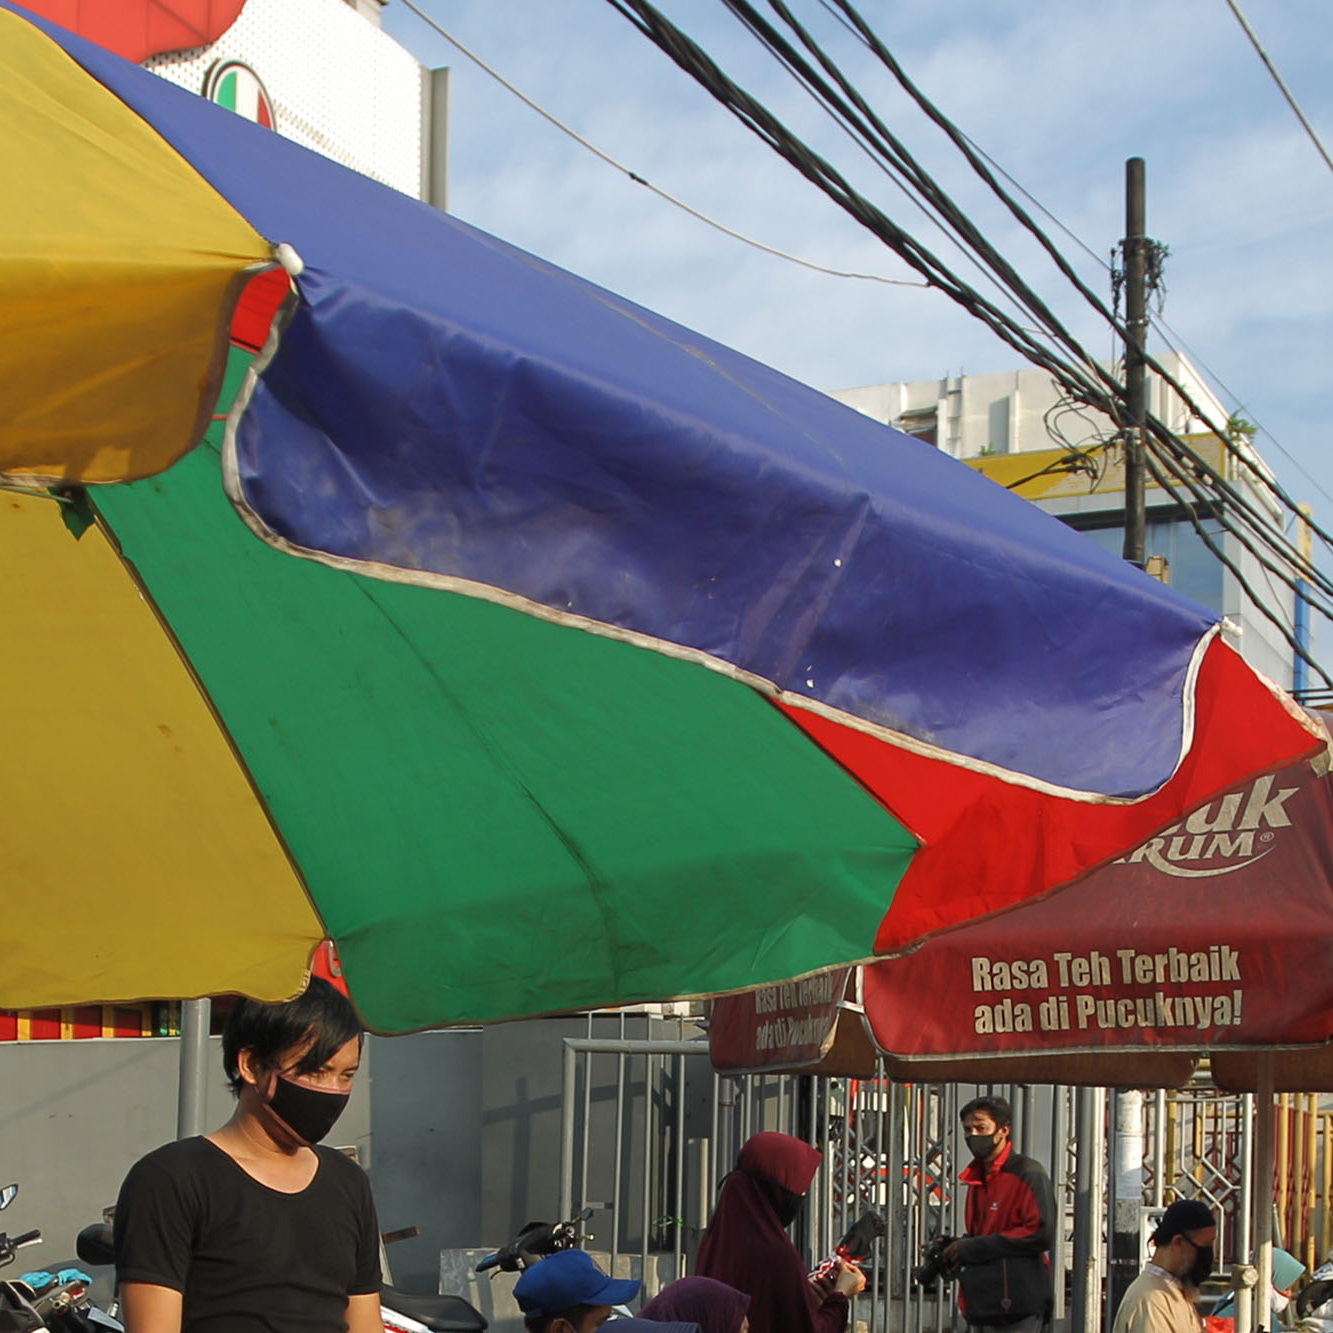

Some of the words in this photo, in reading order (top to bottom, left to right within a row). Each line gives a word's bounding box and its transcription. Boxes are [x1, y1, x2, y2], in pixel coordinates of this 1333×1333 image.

[1112, 831, 1273, 877] RUM
[971, 957, 1049, 992] Rasa
[1053, 951, 1112, 987] Teh
[1117, 945, 1242, 985] Terbaik
[974, 999, 1033, 1034] ada
[1039, 996, 1070, 1031] di
[1075, 990, 1243, 1030] Pucuknya!
